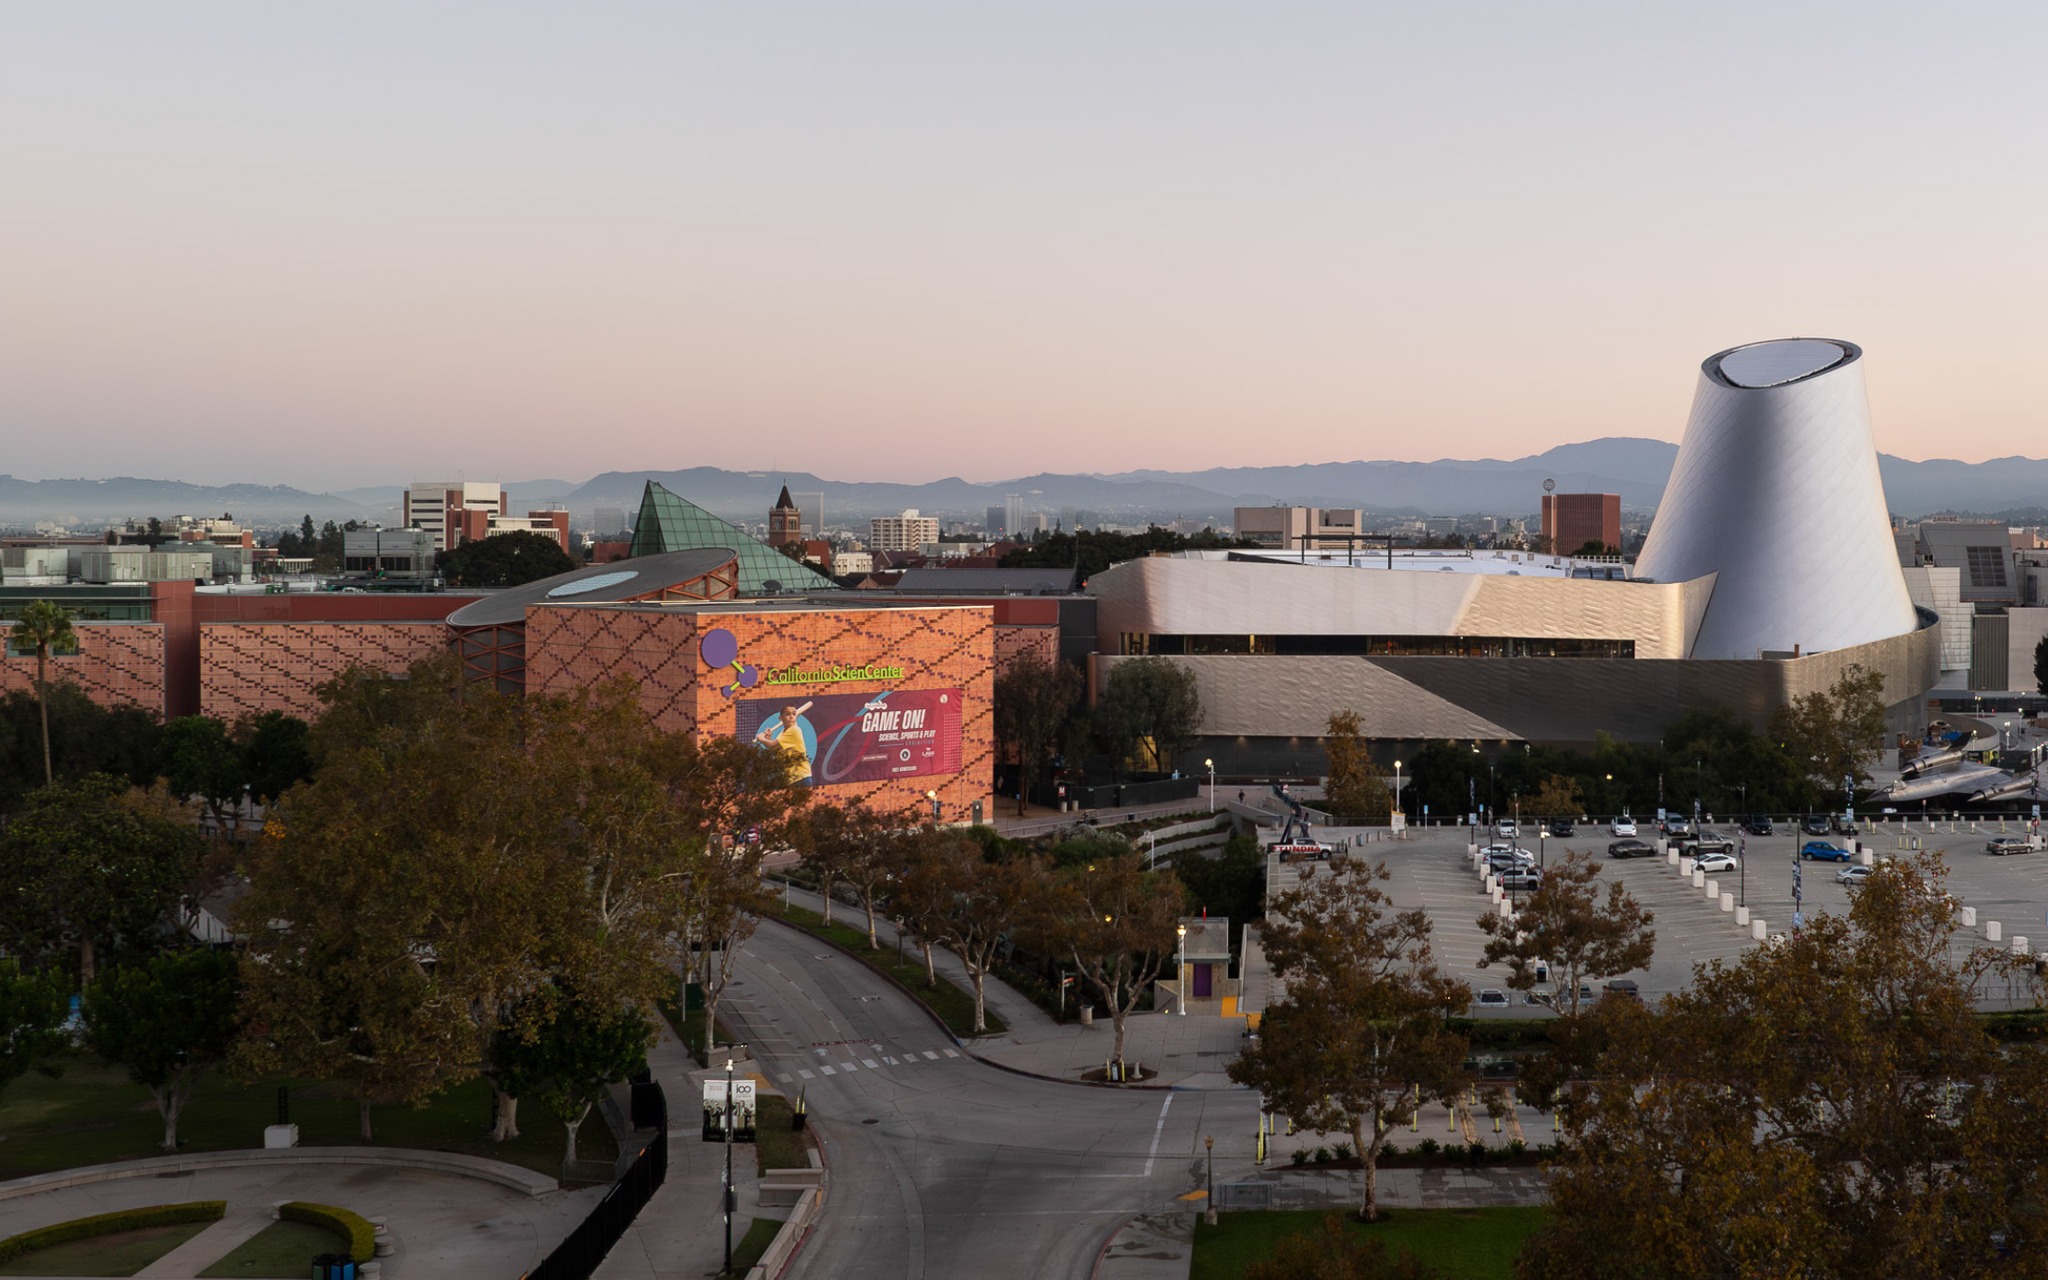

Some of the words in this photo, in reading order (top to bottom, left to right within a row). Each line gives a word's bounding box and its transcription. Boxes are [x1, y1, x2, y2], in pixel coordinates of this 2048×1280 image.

[862, 710, 901, 733] GAME
[902, 709, 926, 730] ON!
[900, 731, 919, 740] SPORTS
[923, 730, 937, 738] PLAY
[1279, 845, 1321, 853] TUNDRA
